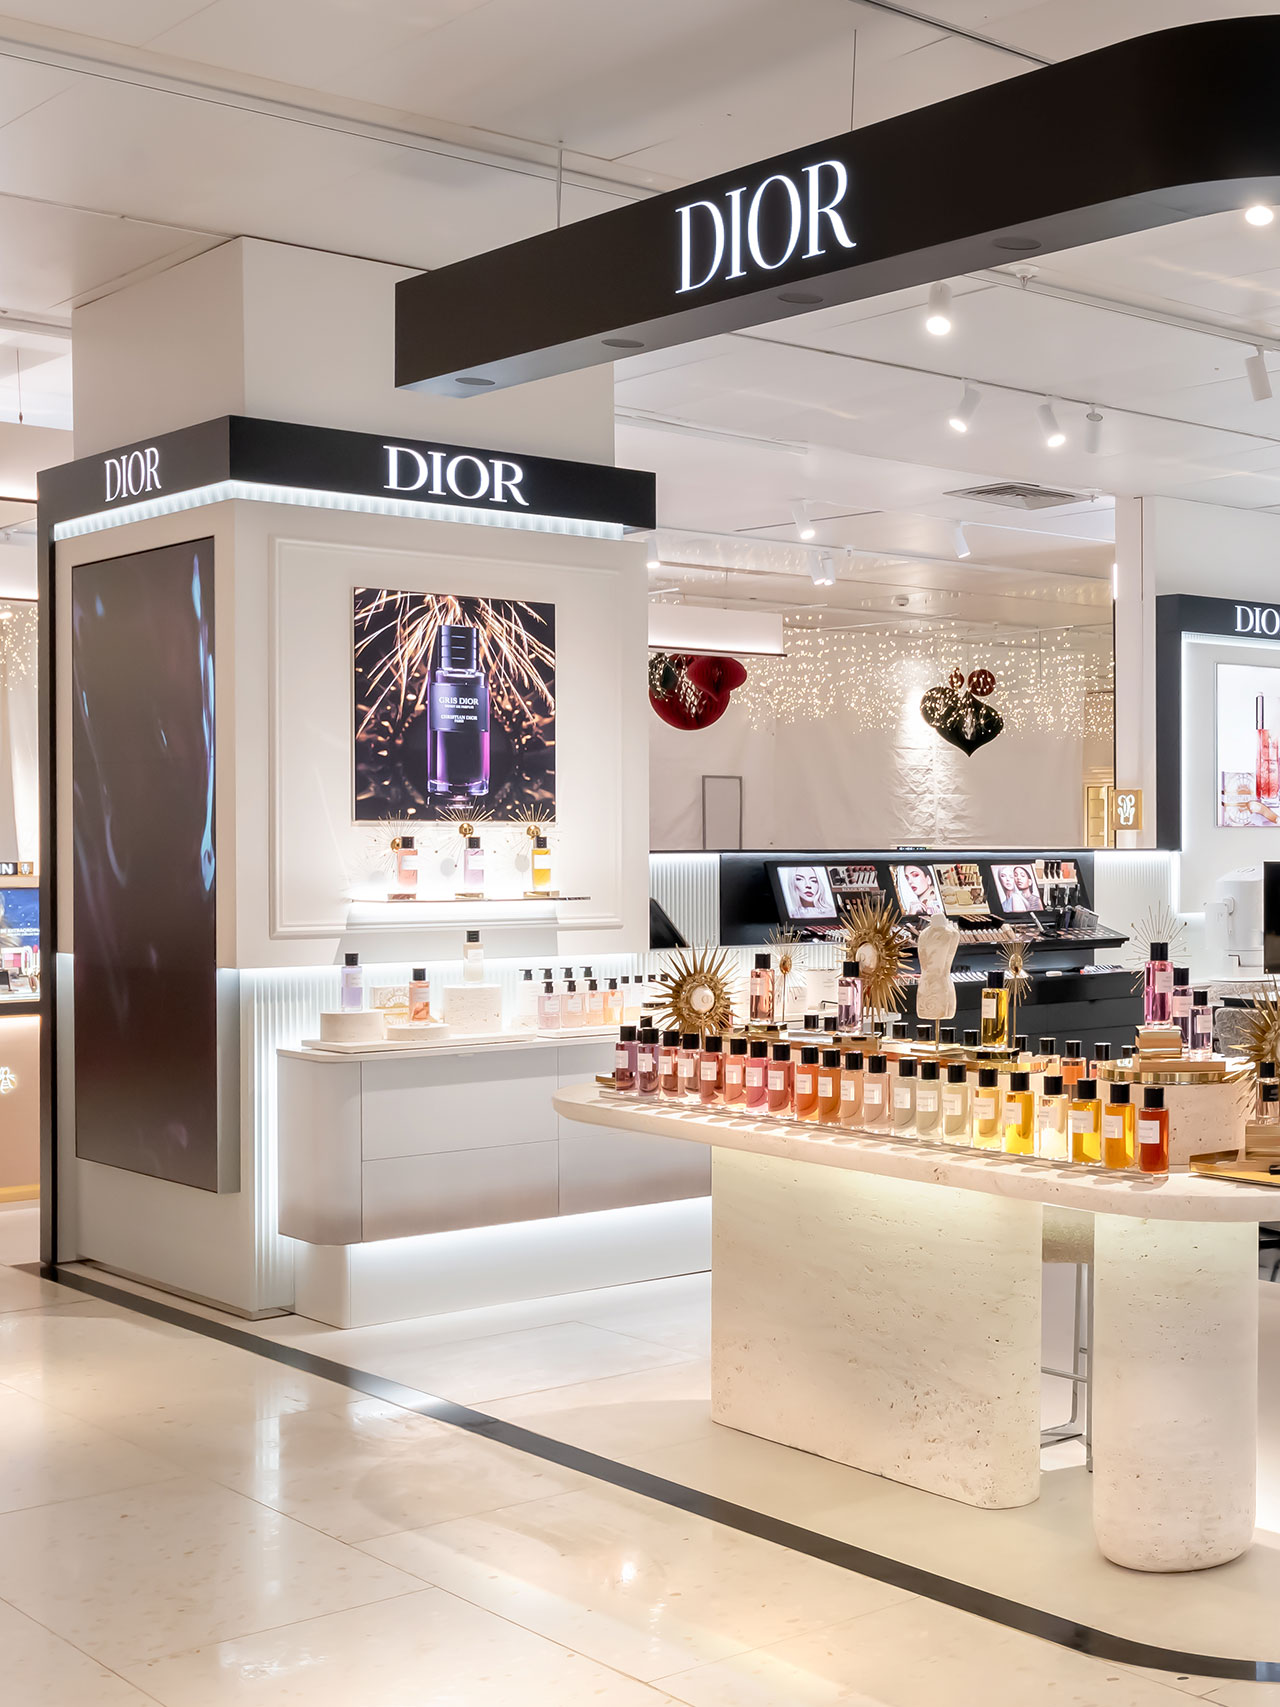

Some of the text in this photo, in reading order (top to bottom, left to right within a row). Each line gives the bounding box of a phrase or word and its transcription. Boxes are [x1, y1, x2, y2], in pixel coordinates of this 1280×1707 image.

[676, 161, 857, 294] DIOR
[103, 447, 162, 502] DIOR
[383, 445, 529, 506] DIOR
[438, 696, 479, 706] GRIS DIOR
